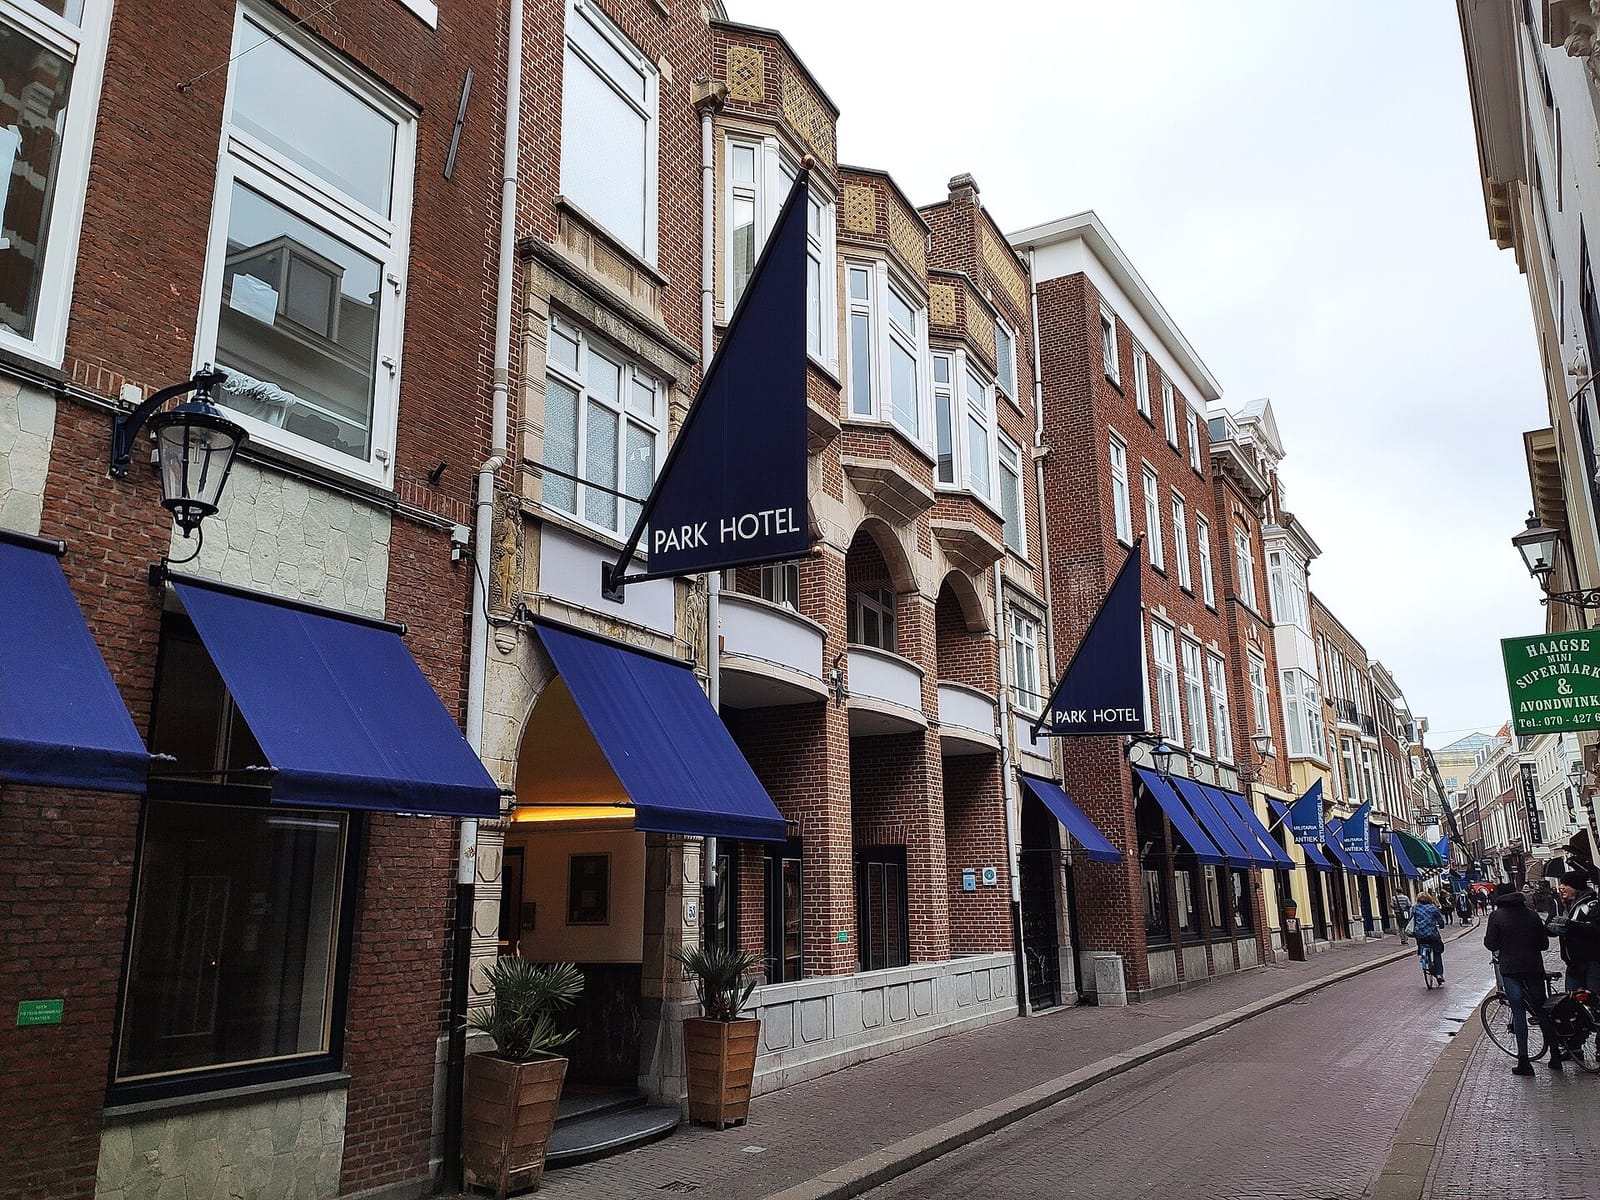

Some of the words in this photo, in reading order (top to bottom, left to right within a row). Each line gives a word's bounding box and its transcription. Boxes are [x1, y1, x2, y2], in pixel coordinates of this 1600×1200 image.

[655, 521, 709, 554] PARK
[720, 507, 800, 544] HOTEL
[1525, 638, 1590, 658] HAAGSE
[1546, 653, 1572, 664] MINI
[1515, 663, 1600, 689] SUPERMARK
[1557, 678, 1573, 695] &
[1520, 695, 1600, 713] AVONDWINK
[1055, 709, 1087, 724] PARK
[1093, 707, 1140, 723] HOTEL
[1518, 718, 1542, 728] Tel.:
[1544, 716, 1563, 726] 070
[1572, 713, 1592, 724] 427
[1420, 815, 1437, 823] JUST
[1530, 811, 1540, 840] HOTEL
